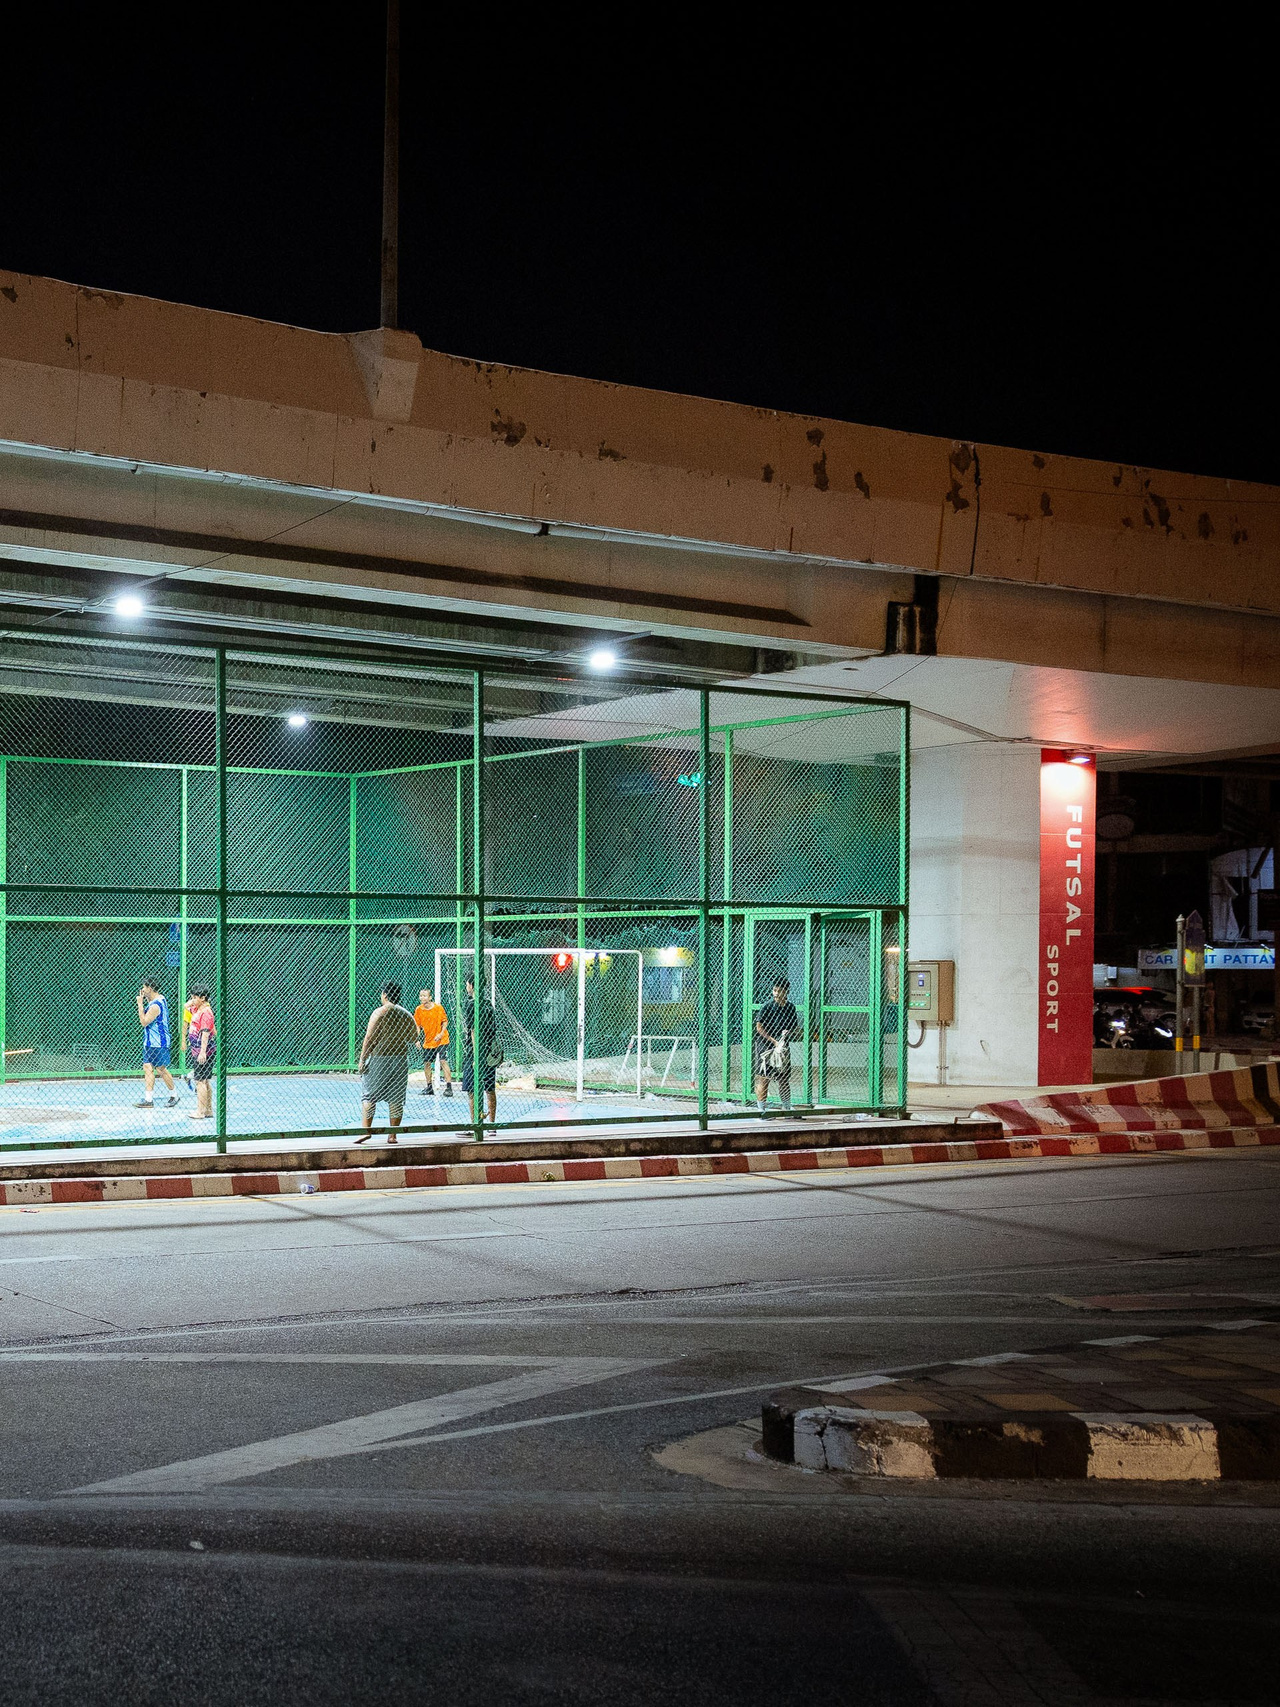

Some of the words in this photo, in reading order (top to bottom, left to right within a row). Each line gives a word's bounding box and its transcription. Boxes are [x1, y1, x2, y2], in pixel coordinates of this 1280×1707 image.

[1065, 805, 1083, 945] FUTSAL
[1046, 945, 1059, 1033] SPORT
[1145, 954, 1174, 965] CAR
